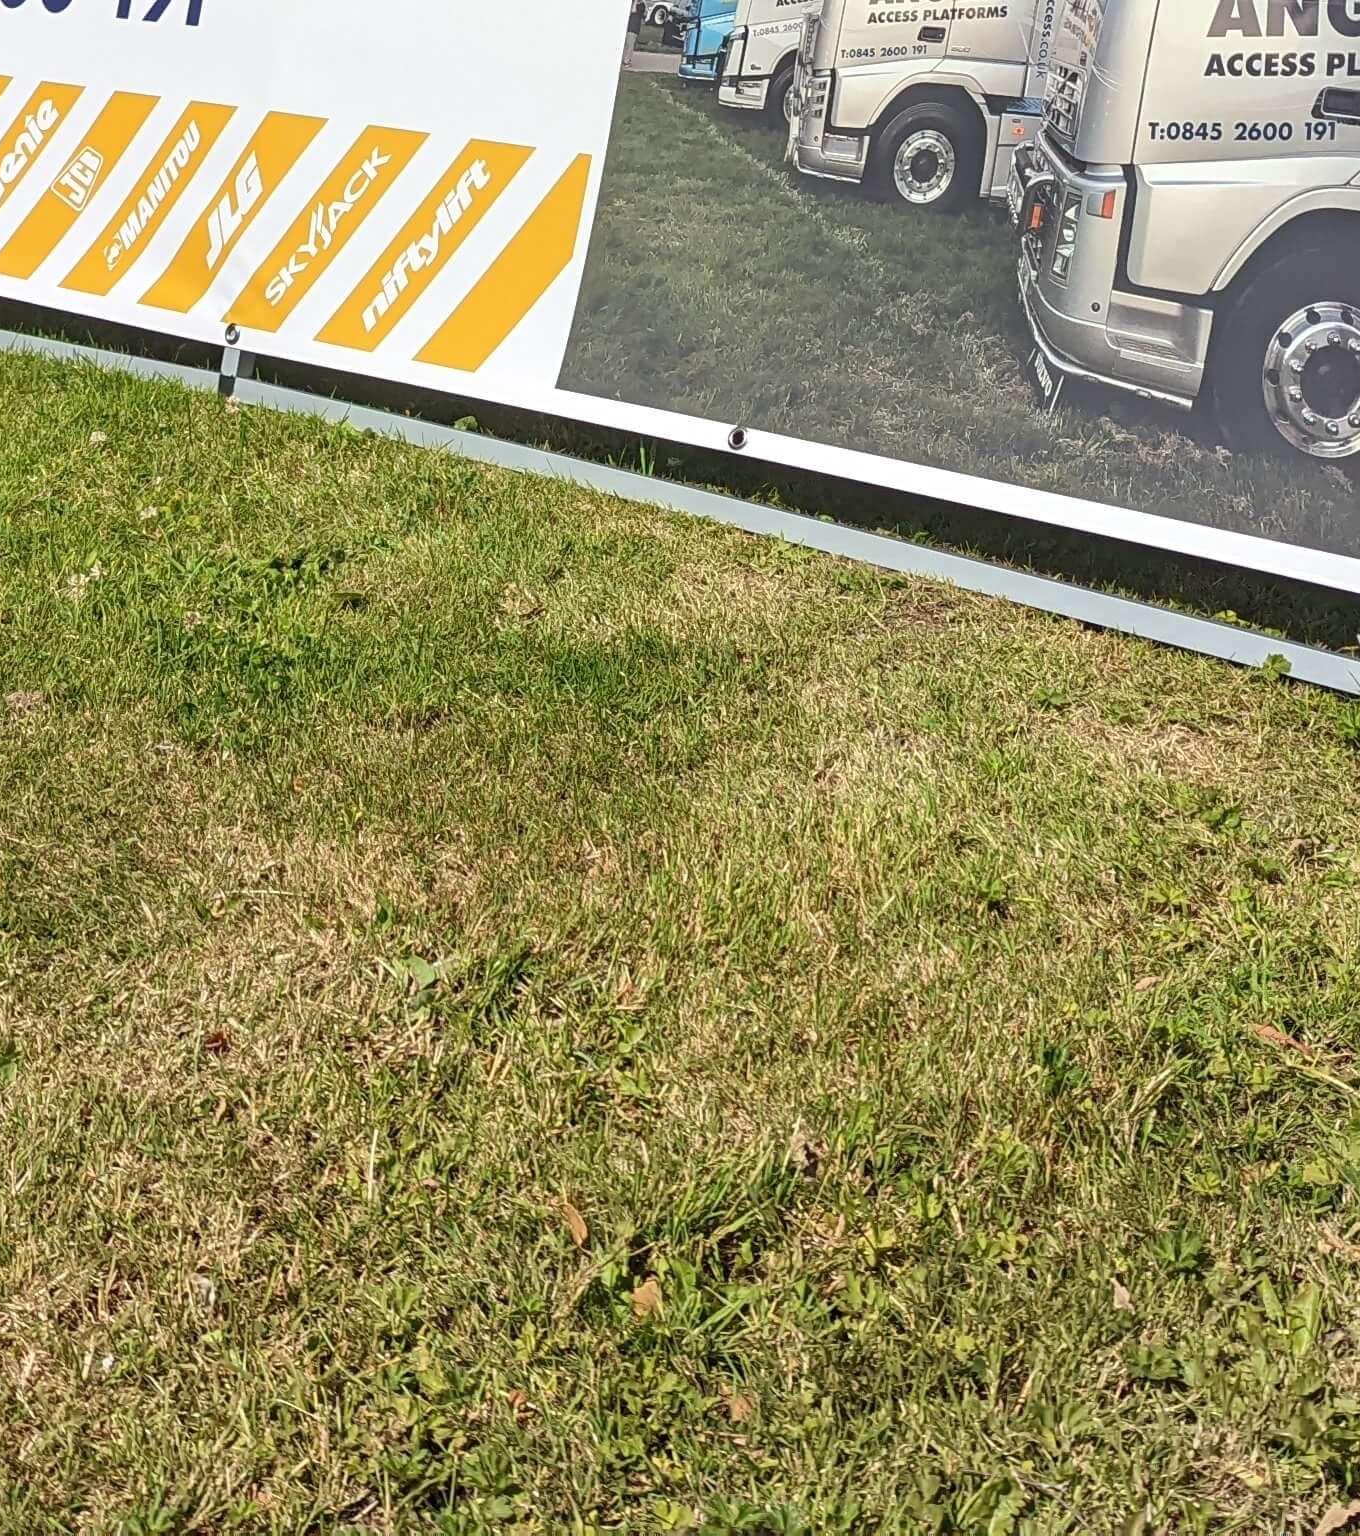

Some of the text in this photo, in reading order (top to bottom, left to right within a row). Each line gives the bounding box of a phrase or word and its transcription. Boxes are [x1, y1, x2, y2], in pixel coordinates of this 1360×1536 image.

[867, 5, 1009, 25] ACCESS PLATFORMS
[841, 44, 927, 59] T:0845 2600 191
[1204, 52, 1316, 77] ACCESS
[1148, 121, 1336, 141] T:0845 2600 191
[64, 152, 101, 206] JCB
[120, 120, 201, 250] MANITOU
[204, 150, 264, 267] JLG
[360, 158, 491, 333] niftylift
